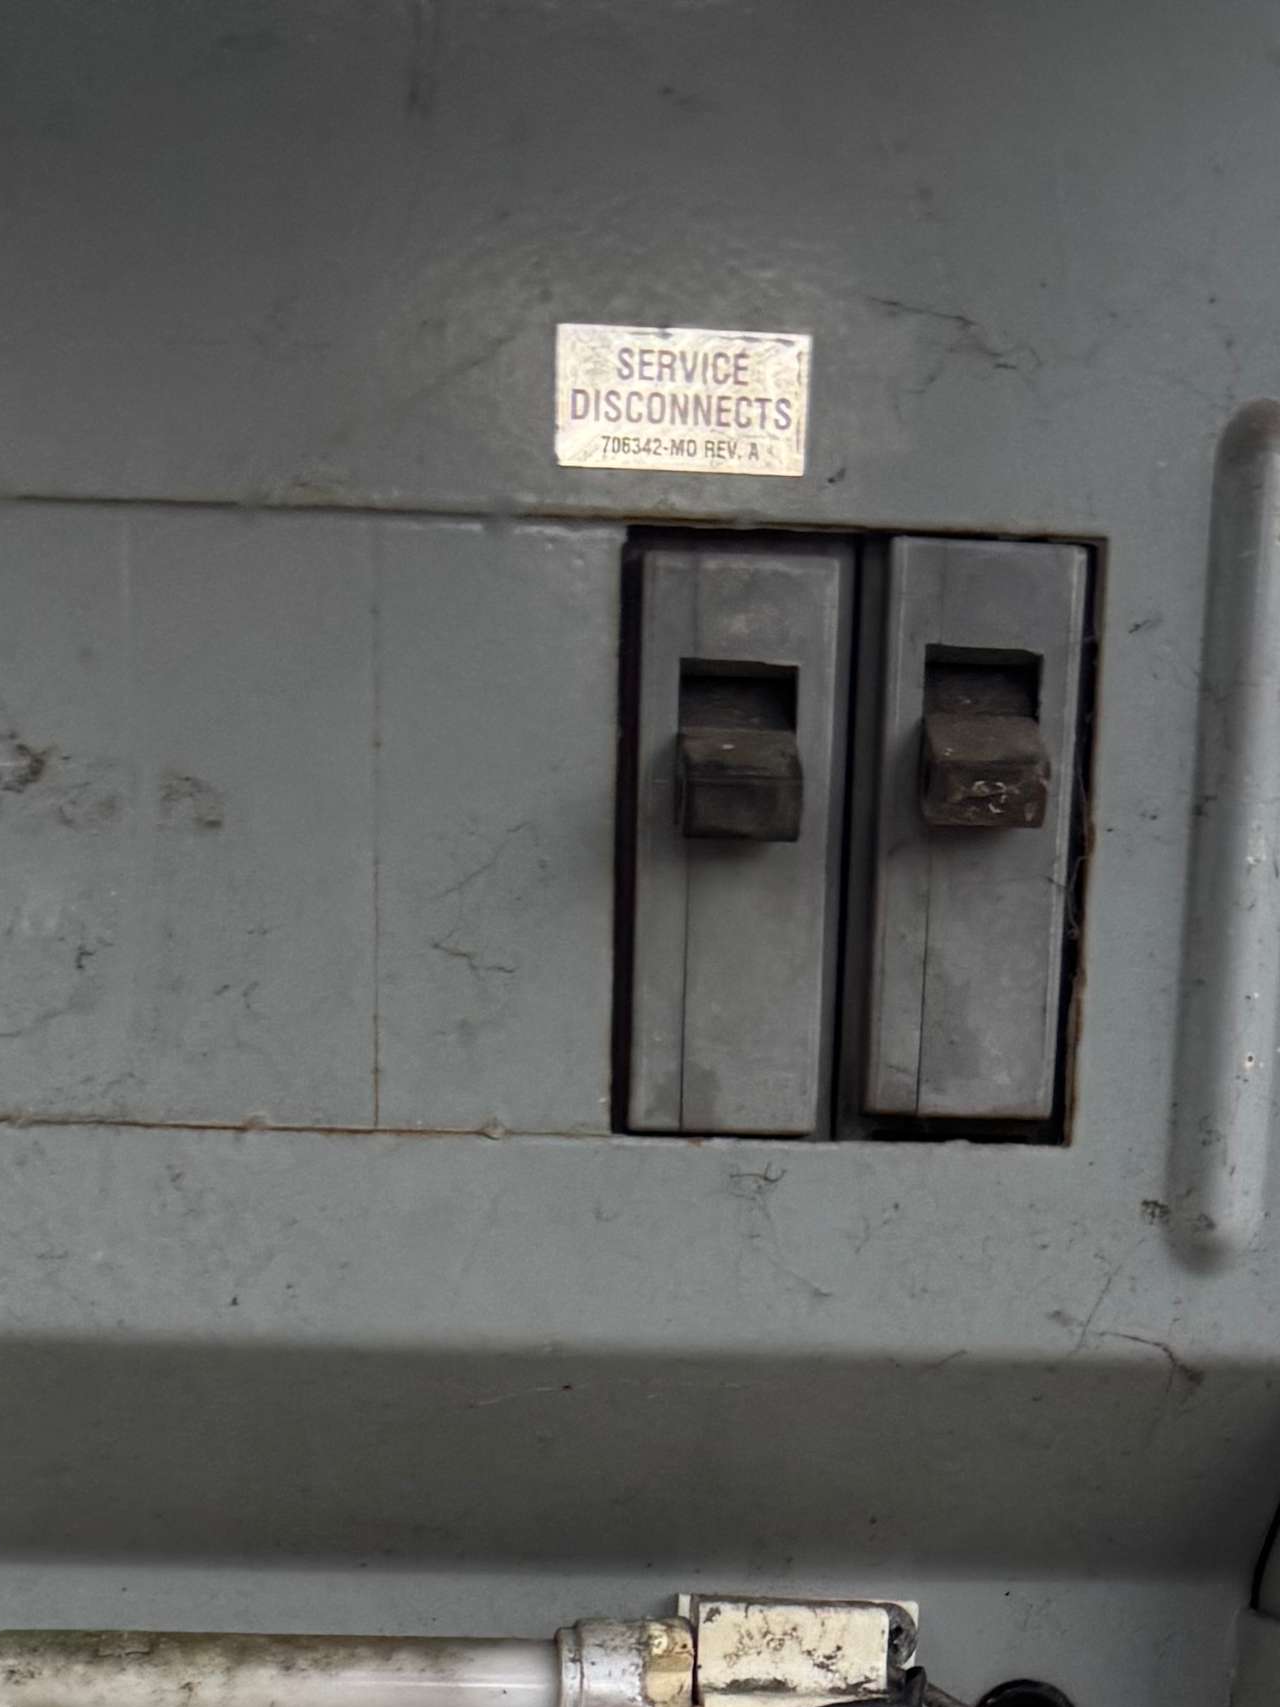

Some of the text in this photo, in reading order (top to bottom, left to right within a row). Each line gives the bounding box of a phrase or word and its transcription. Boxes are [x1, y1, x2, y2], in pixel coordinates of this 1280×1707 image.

[616, 347, 750, 386] SERVICE
[570, 388, 792, 430] DISCONNECTS
[704, 440, 742, 460] REV.
[747, 442, 760, 461] A
